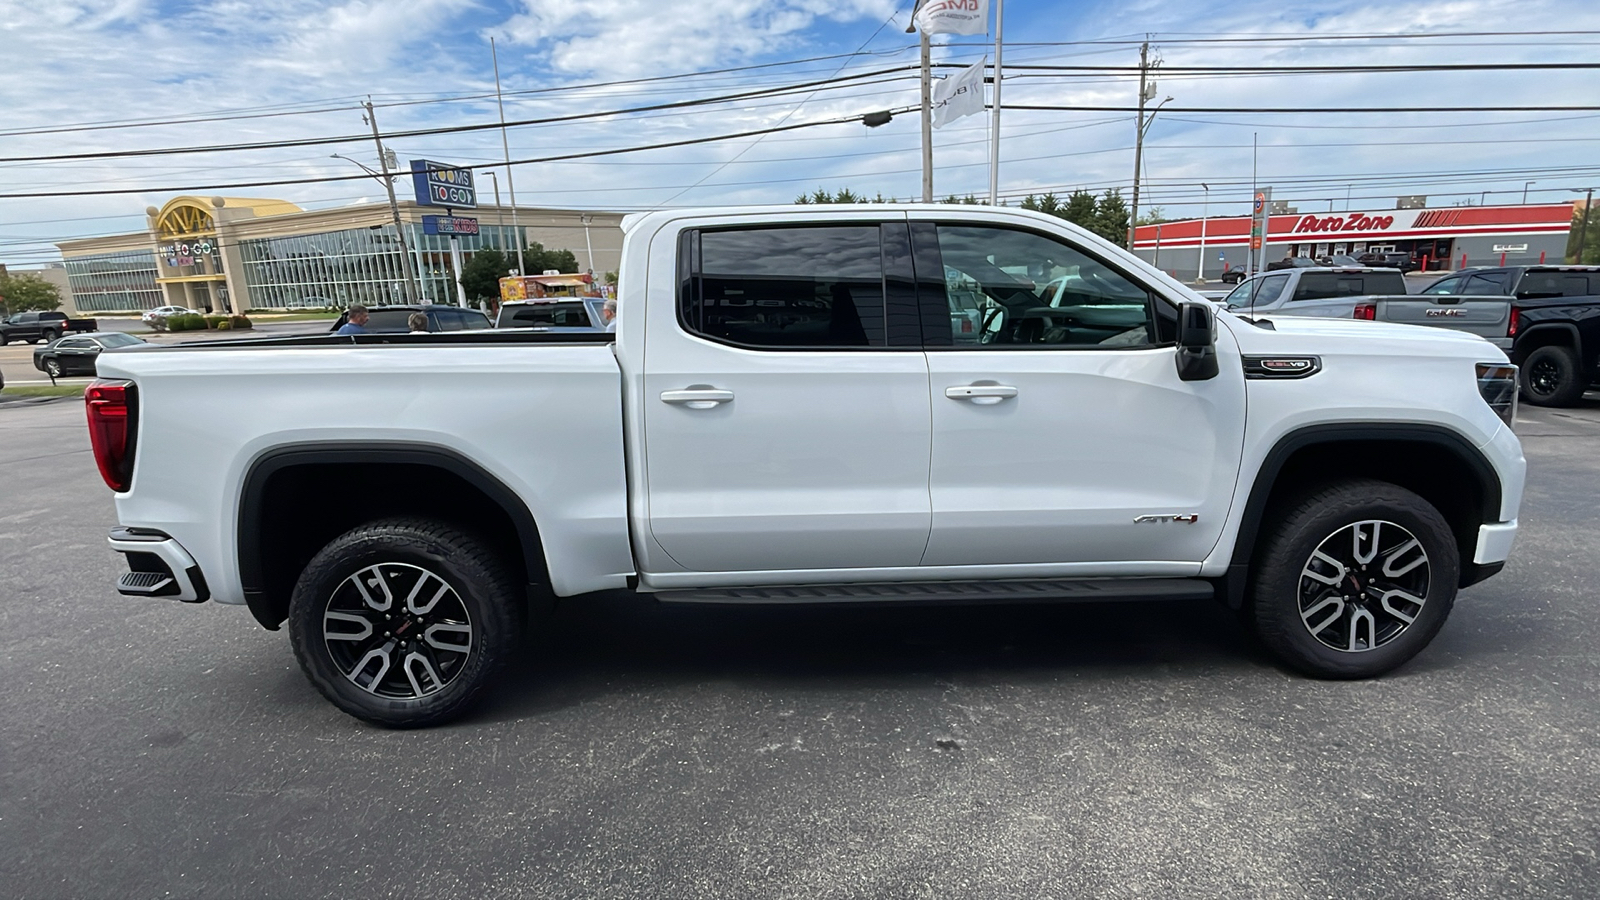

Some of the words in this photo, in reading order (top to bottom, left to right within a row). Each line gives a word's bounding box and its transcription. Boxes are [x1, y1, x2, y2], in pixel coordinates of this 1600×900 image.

[430, 166, 469, 185] ROOMS
[433, 185, 448, 201] TO
[450, 188, 466, 203] GO
[453, 217, 478, 234] KIDS
[1295, 213, 1394, 233] AutoZone
[1426, 308, 1467, 317] GMC
